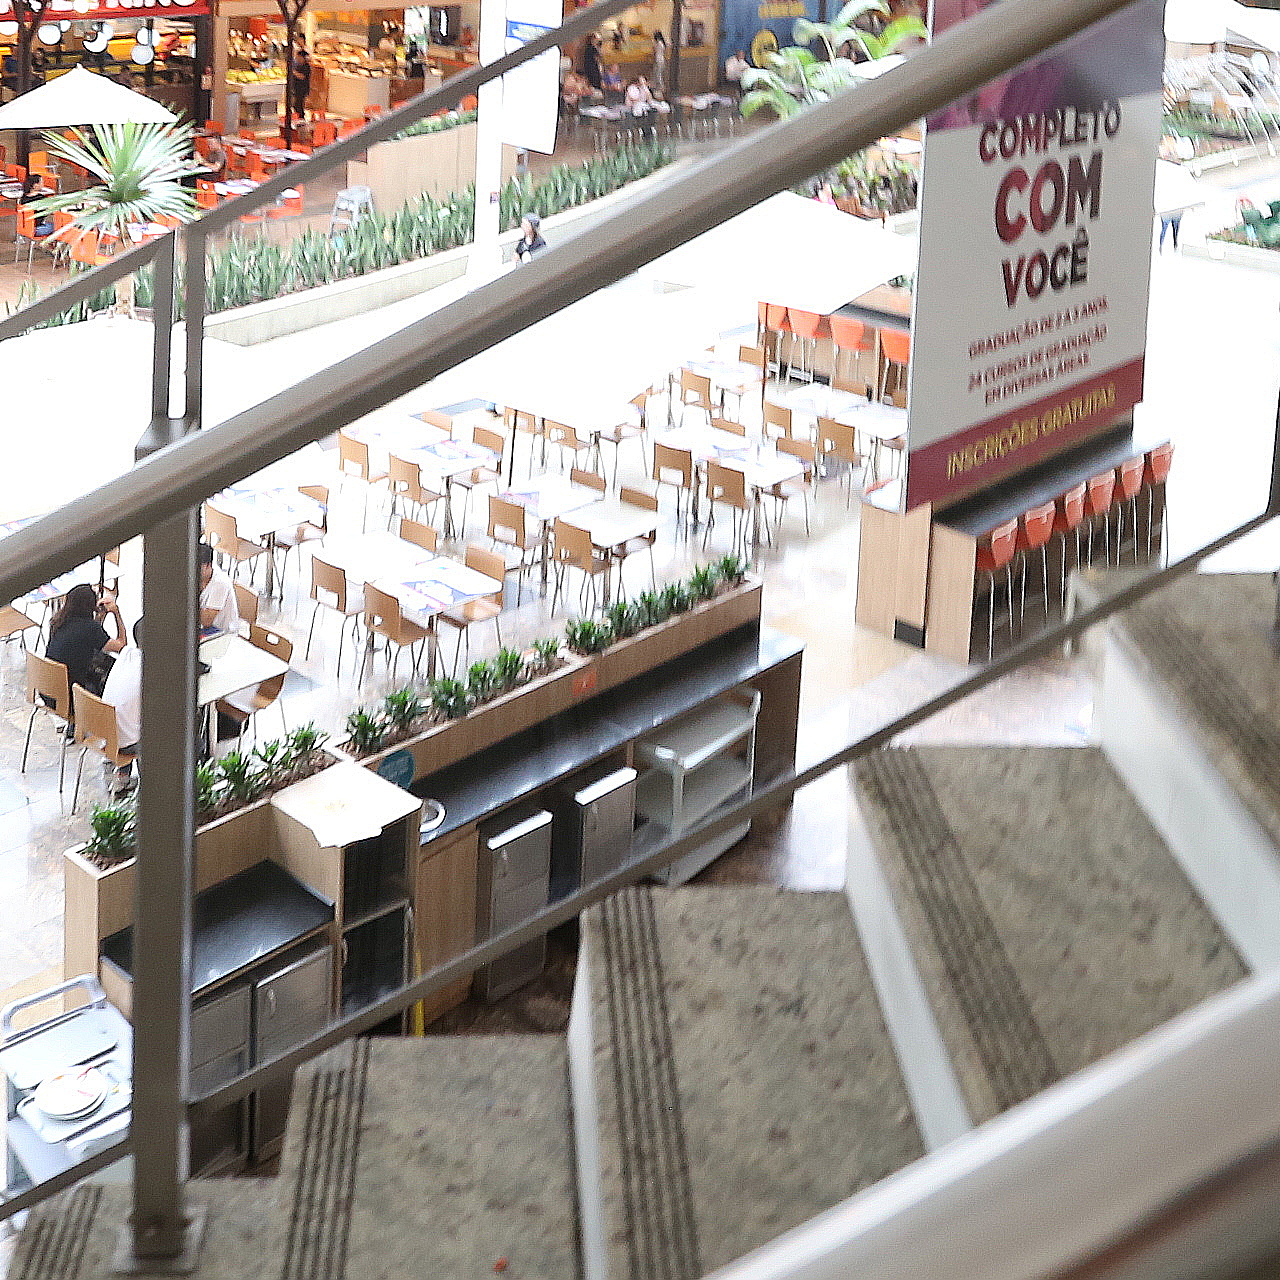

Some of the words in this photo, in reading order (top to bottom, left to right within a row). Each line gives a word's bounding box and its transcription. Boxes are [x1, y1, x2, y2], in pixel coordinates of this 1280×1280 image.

[979, 100, 1121, 163] COMPLETO
[995, 149, 1104, 245] COM
[1001, 226, 1090, 308] VOCÊ
[947, 417, 1040, 480] INSCRIÇÕES
[1040, 381, 1117, 436] GRATUITAS
